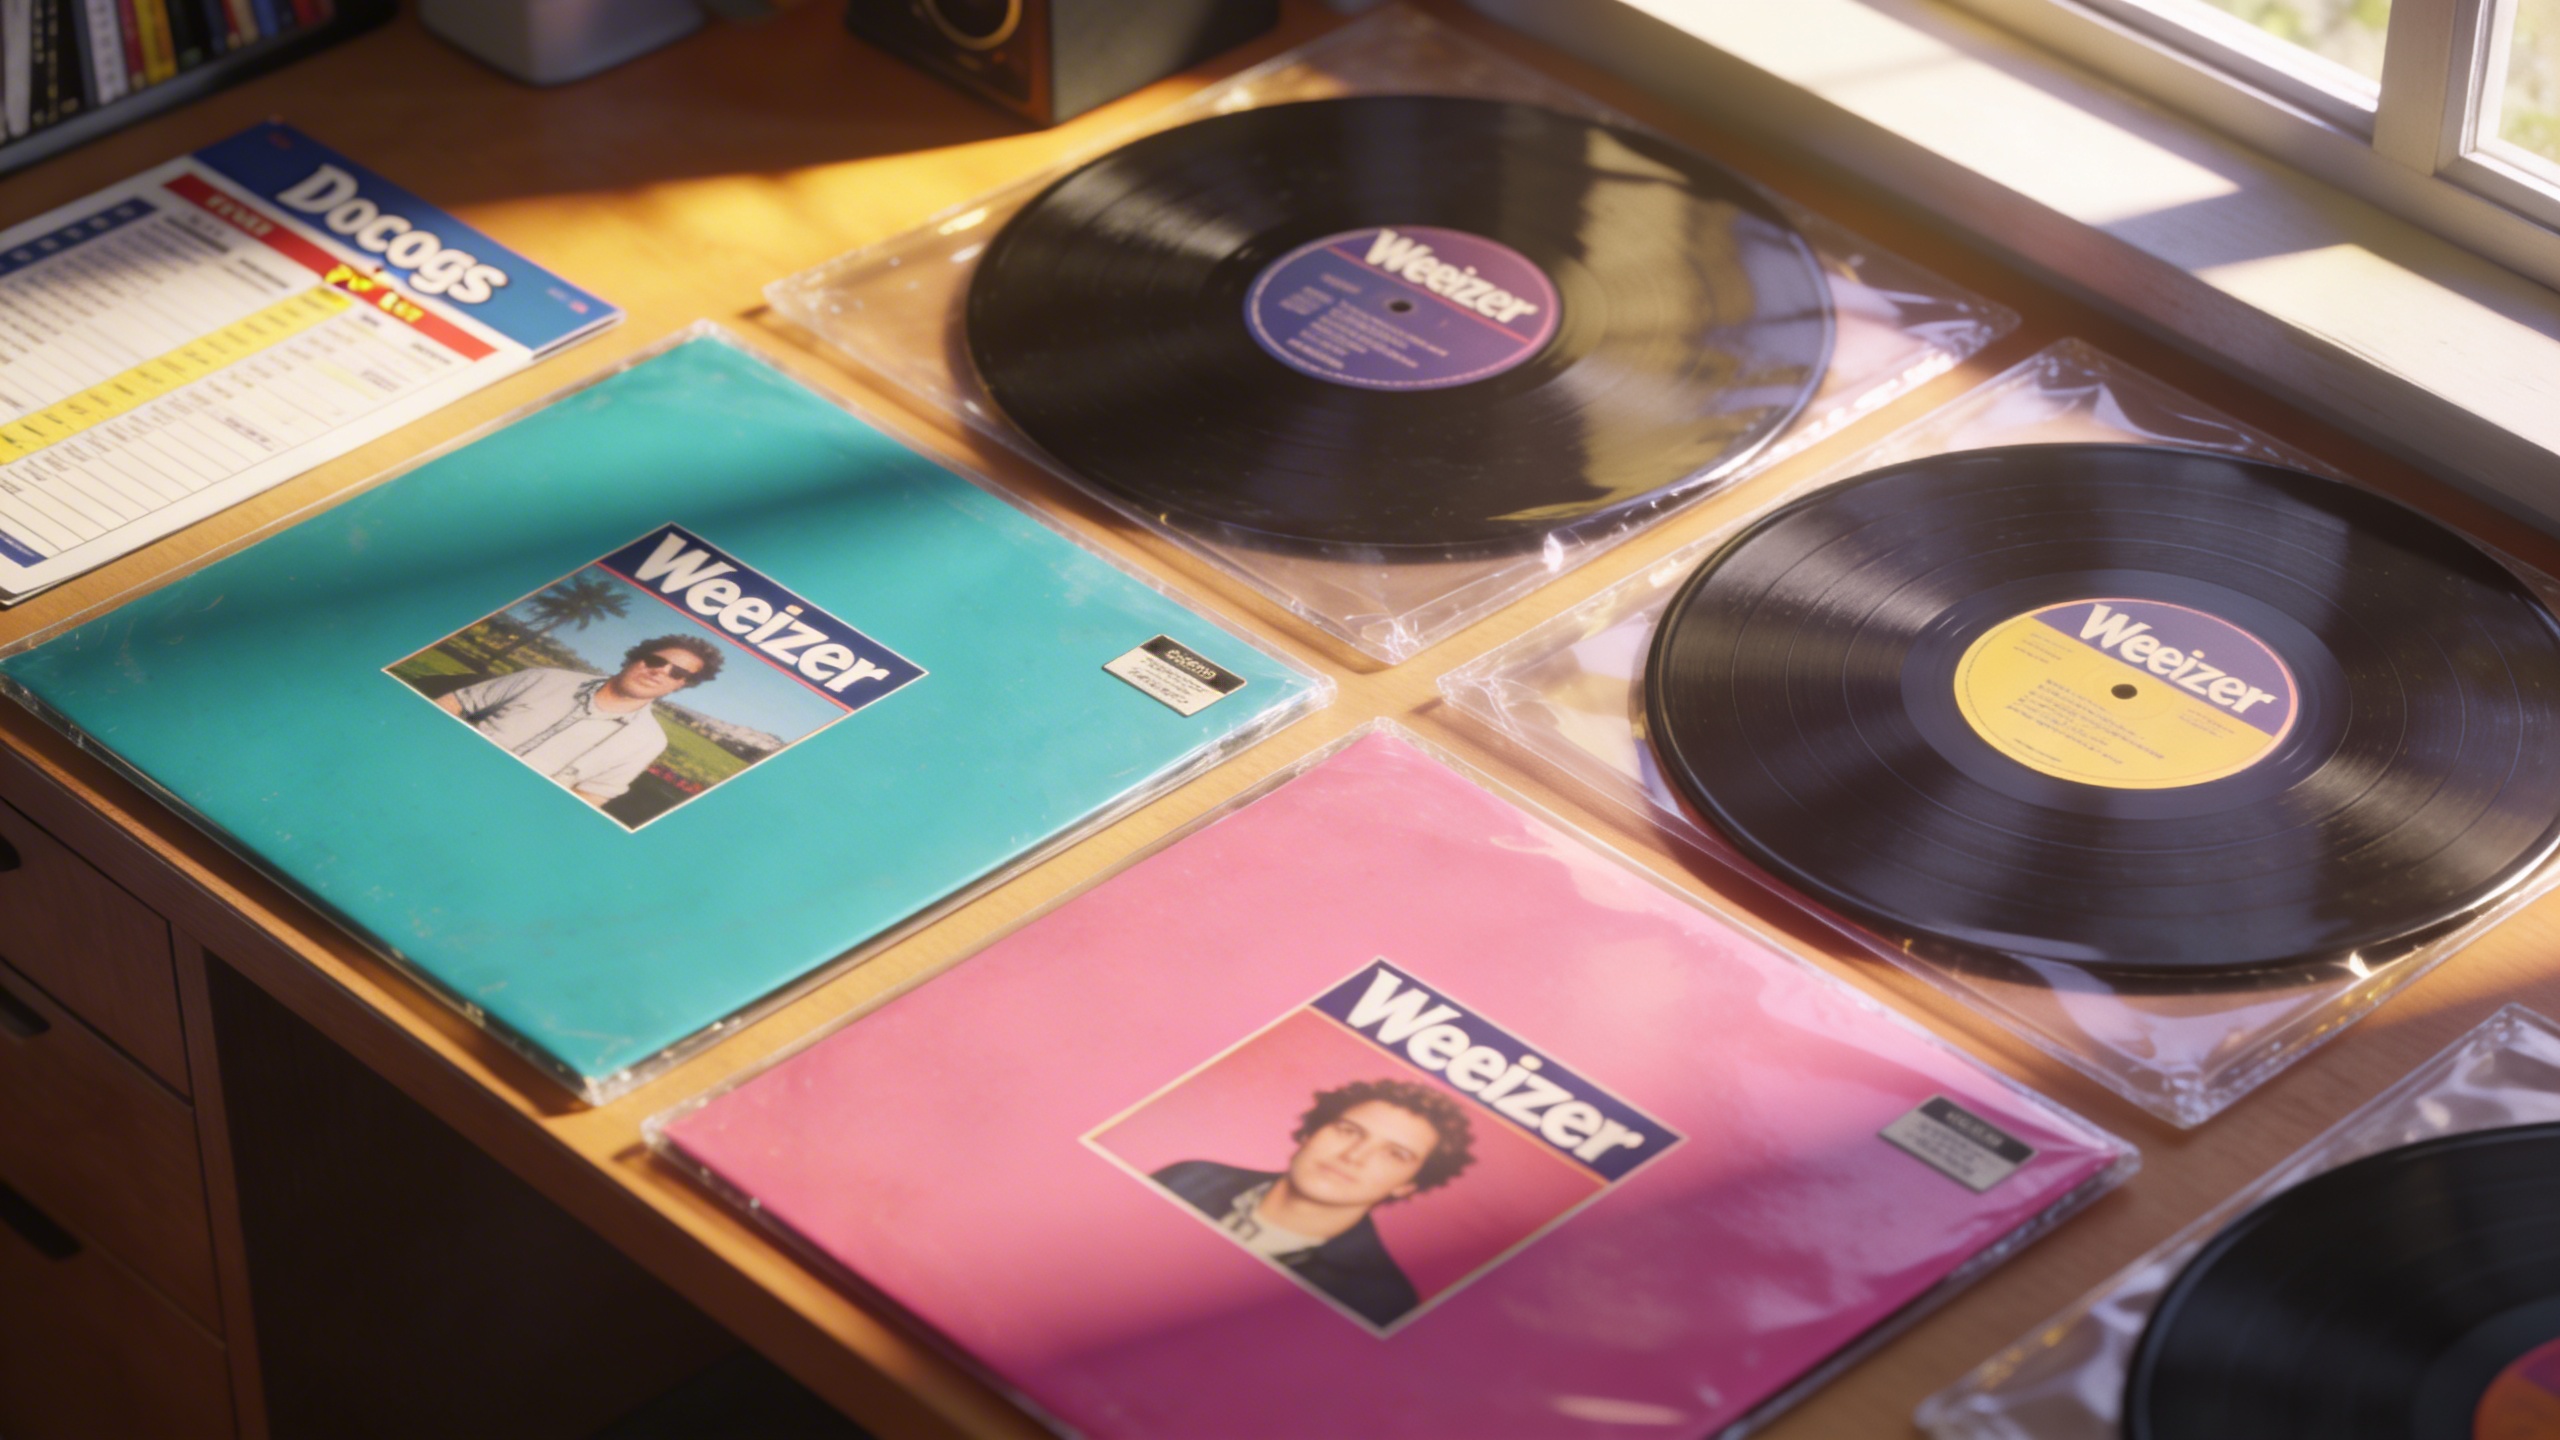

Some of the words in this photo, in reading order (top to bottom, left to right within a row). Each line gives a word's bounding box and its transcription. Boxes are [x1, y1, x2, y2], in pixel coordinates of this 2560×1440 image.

[275, 163, 509, 304] Docogs
[1364, 228, 1539, 323] Weeizer
[634, 532, 890, 693] Weeizer
[2079, 603, 2277, 713] Weeizer
[1346, 967, 1645, 1163] Weeizer
